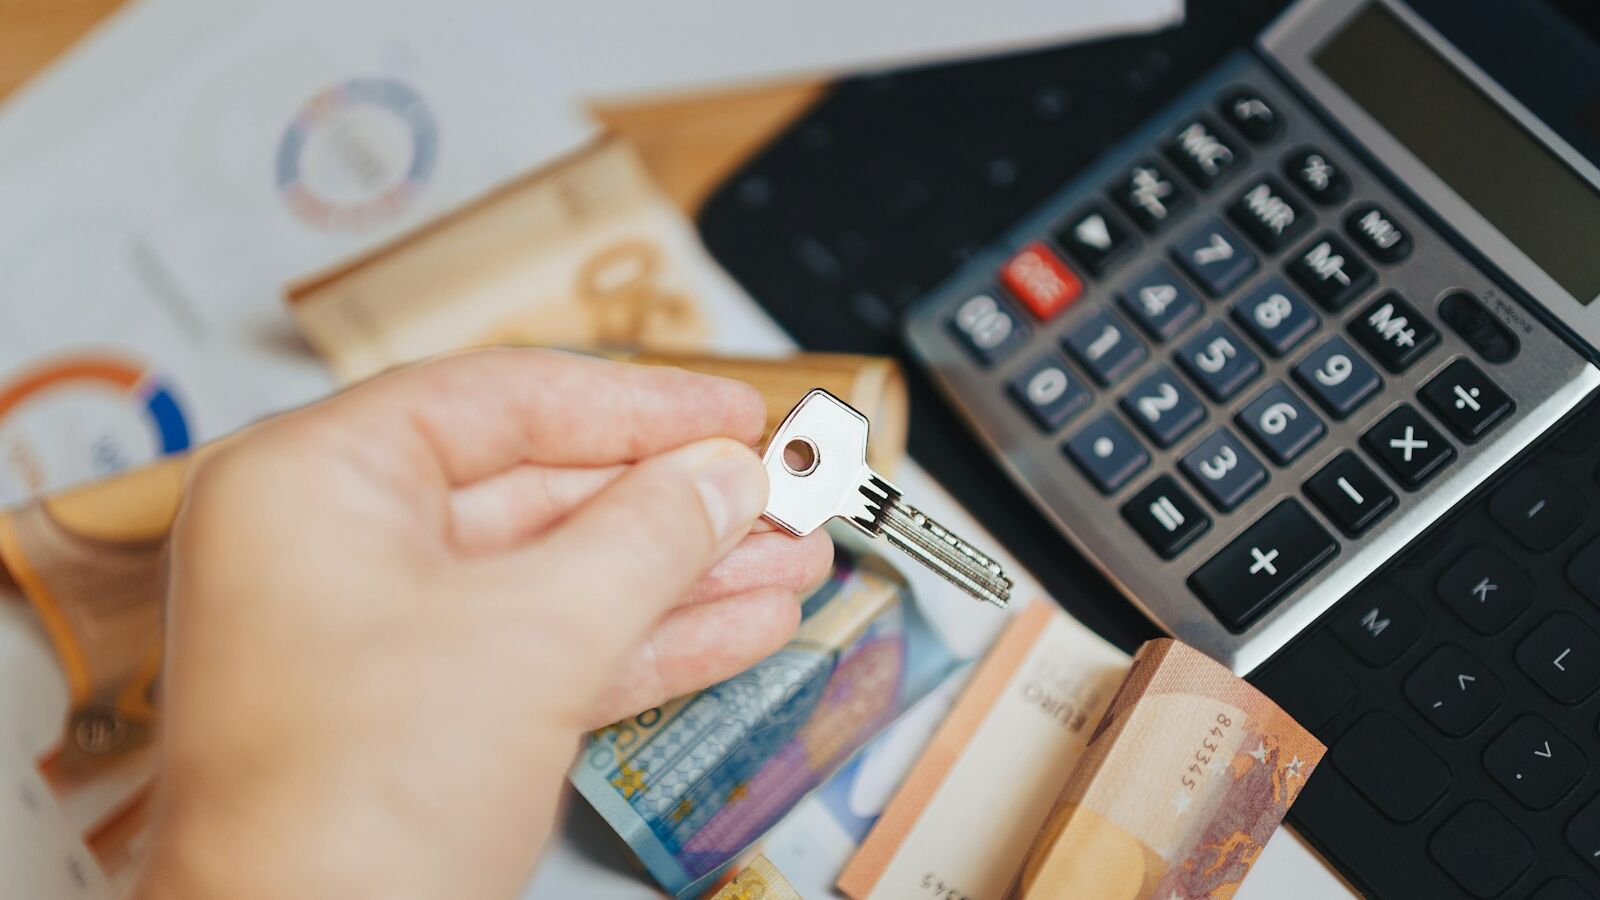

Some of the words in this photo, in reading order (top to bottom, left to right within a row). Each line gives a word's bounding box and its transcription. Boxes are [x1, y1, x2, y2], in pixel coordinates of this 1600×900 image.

[1245, 183, 1294, 235] MR
[1194, 233, 1233, 265] 7
[1140, 284, 1178, 317] 4
[1254, 293, 1292, 330] 8
[1086, 324, 1121, 360] 1
[1368, 302, 1415, 348] M+
[1196, 336, 1237, 373] 5
[1315, 353, 1353, 387] 9
[1027, 367, 1068, 405] 0
[1138, 382, 1179, 422] 2
[1259, 402, 1298, 435] 6
[1200, 445, 1238, 480] 3
[1472, 577, 1499, 603] K
[1361, 607, 1391, 637] M
[1552, 647, 1571, 671] L
[1023, 682, 1088, 734] EURO
[1181, 712, 1232, 791] 843345
